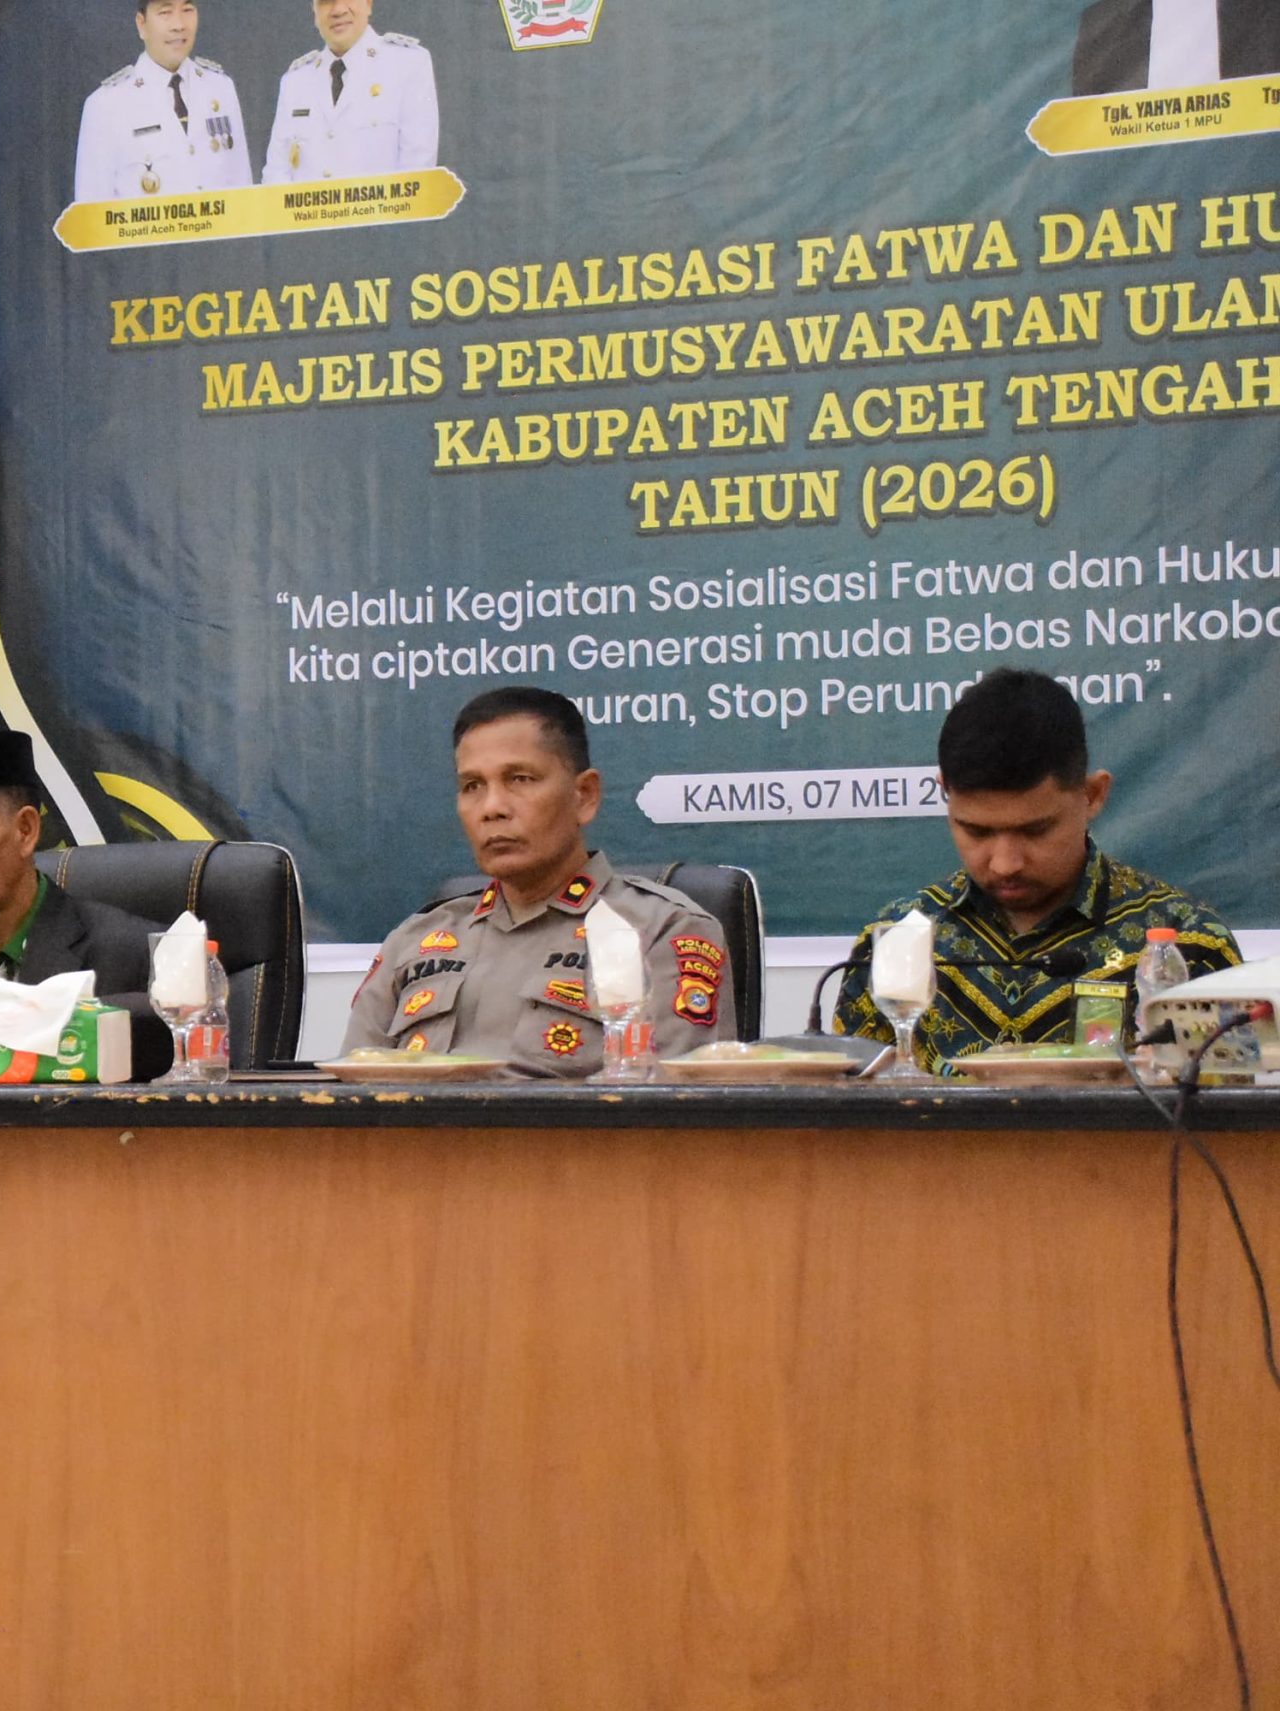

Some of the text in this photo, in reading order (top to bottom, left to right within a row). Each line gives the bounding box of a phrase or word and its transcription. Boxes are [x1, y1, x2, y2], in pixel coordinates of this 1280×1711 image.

[1110, 123, 1142, 136] Wakil
[1146, 120, 1180, 132] Ketua
[1194, 114, 1222, 127] MPU
[1136, 98, 1182, 118] YAHYA
[1185, 92, 1231, 113] ARIAS
[105, 210, 128, 225] Drs.
[131, 206, 160, 223] HAILI
[199, 200, 225, 216] M.Si
[284, 181, 420, 209] MUCHSIN HASAN, M.SP
[293, 202, 411, 221] Wakil Bupati Aceh Tengah
[118, 220, 212, 238] Bupati Aceh Tengah
[111, 278, 391, 345] KEGIATAN
[411, 243, 776, 320] SOSIALISASI
[797, 220, 1018, 287] FATWA
[1039, 202, 1177, 264] DAN
[202, 348, 443, 410] MAJELIS
[463, 291, 1103, 391] PERMUSYAWARATAN
[434, 355, 1280, 467] KABUPATEN ACEH TENGAH
[631, 454, 1055, 530] TAHUN (2026)
[276, 586, 434, 630] “Melalui
[446, 580, 636, 632] Kegiatan
[648, 560, 877, 612] Sosialisasi
[891, 559, 1034, 599] Fatwa
[1048, 550, 1143, 591] dan
[288, 644, 360, 683] kita
[371, 638, 555, 690] ciptakan
[567, 622, 763, 671] Generasi
[776, 618, 911, 661] muda
[926, 612, 1071, 654] Bebas
[707, 682, 808, 730] Stop
[683, 782, 793, 815] KAMIS,
[803, 780, 841, 809] 07
[852, 778, 907, 808] MEI
